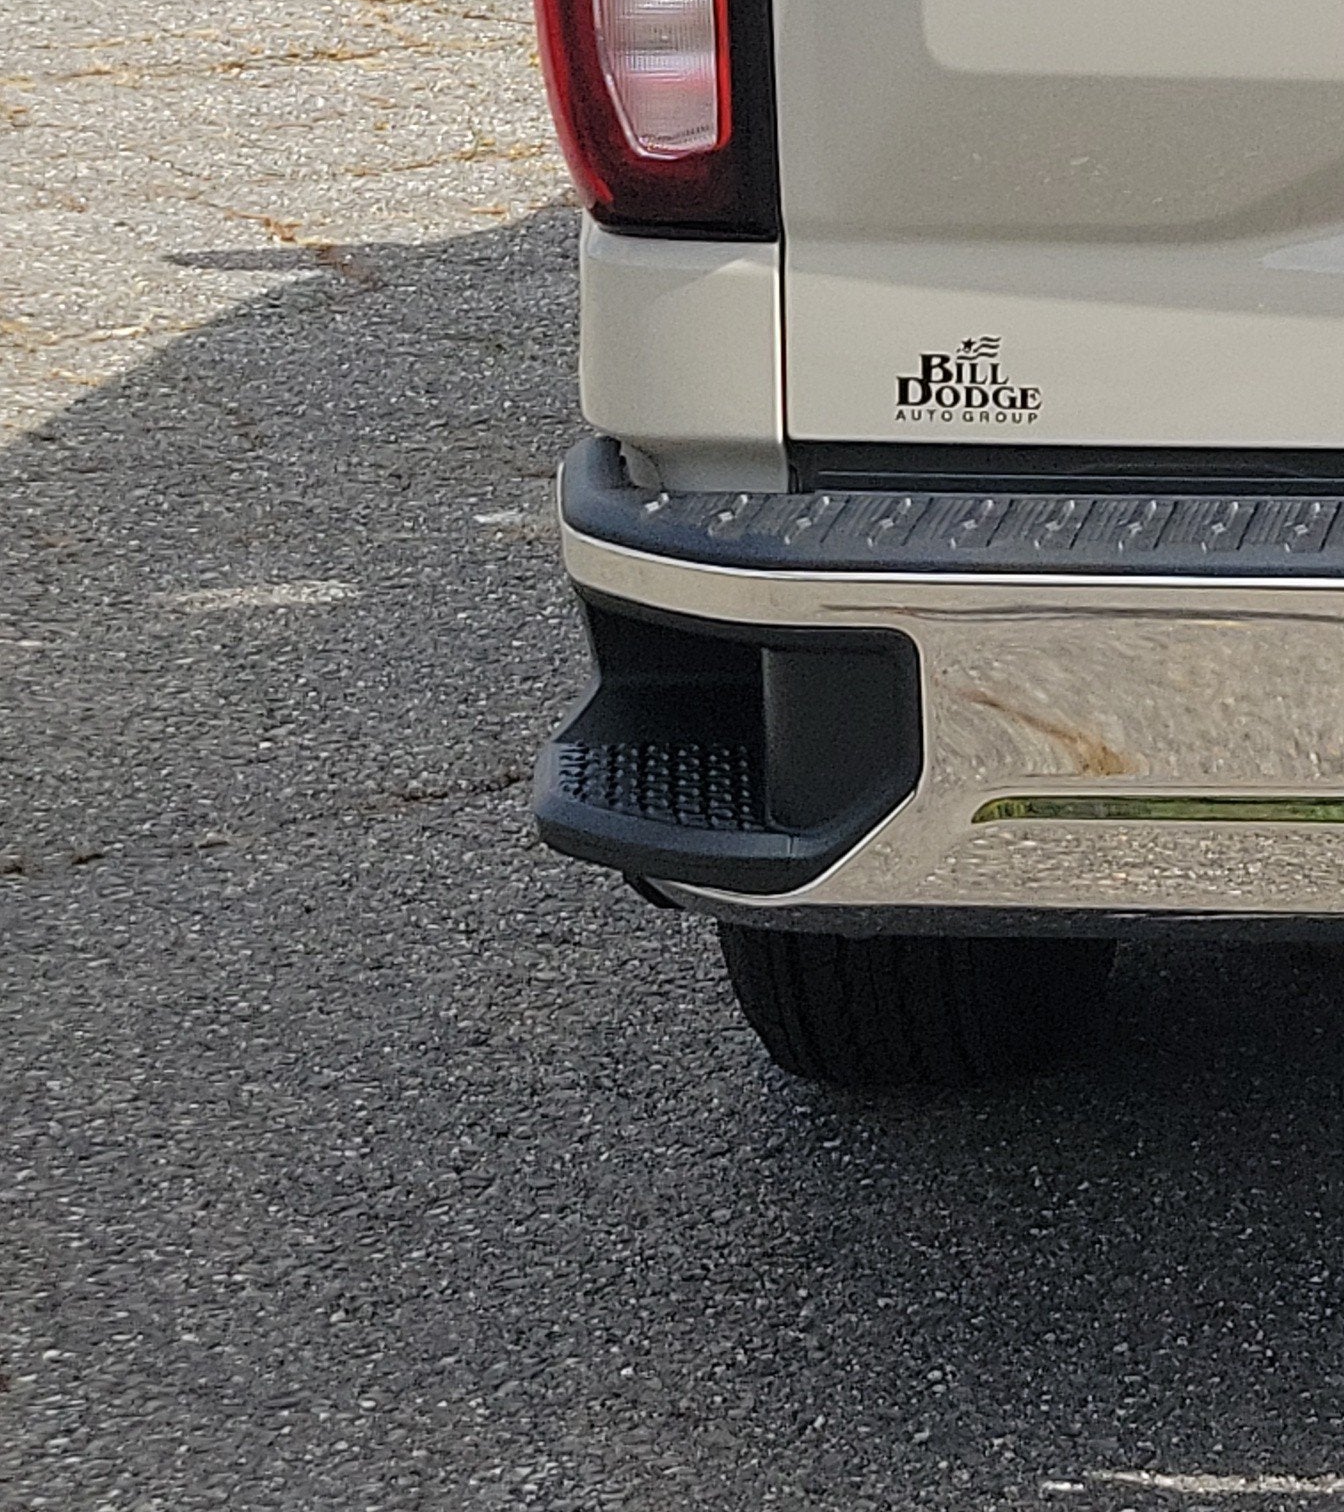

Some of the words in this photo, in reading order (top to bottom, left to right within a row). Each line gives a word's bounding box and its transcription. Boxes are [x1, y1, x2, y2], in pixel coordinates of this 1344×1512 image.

[920, 353, 1009, 385] BILL
[896, 376, 1042, 410] DODGE
[895, 409, 953, 422] AUTO
[962, 410, 1039, 424] GROUP
